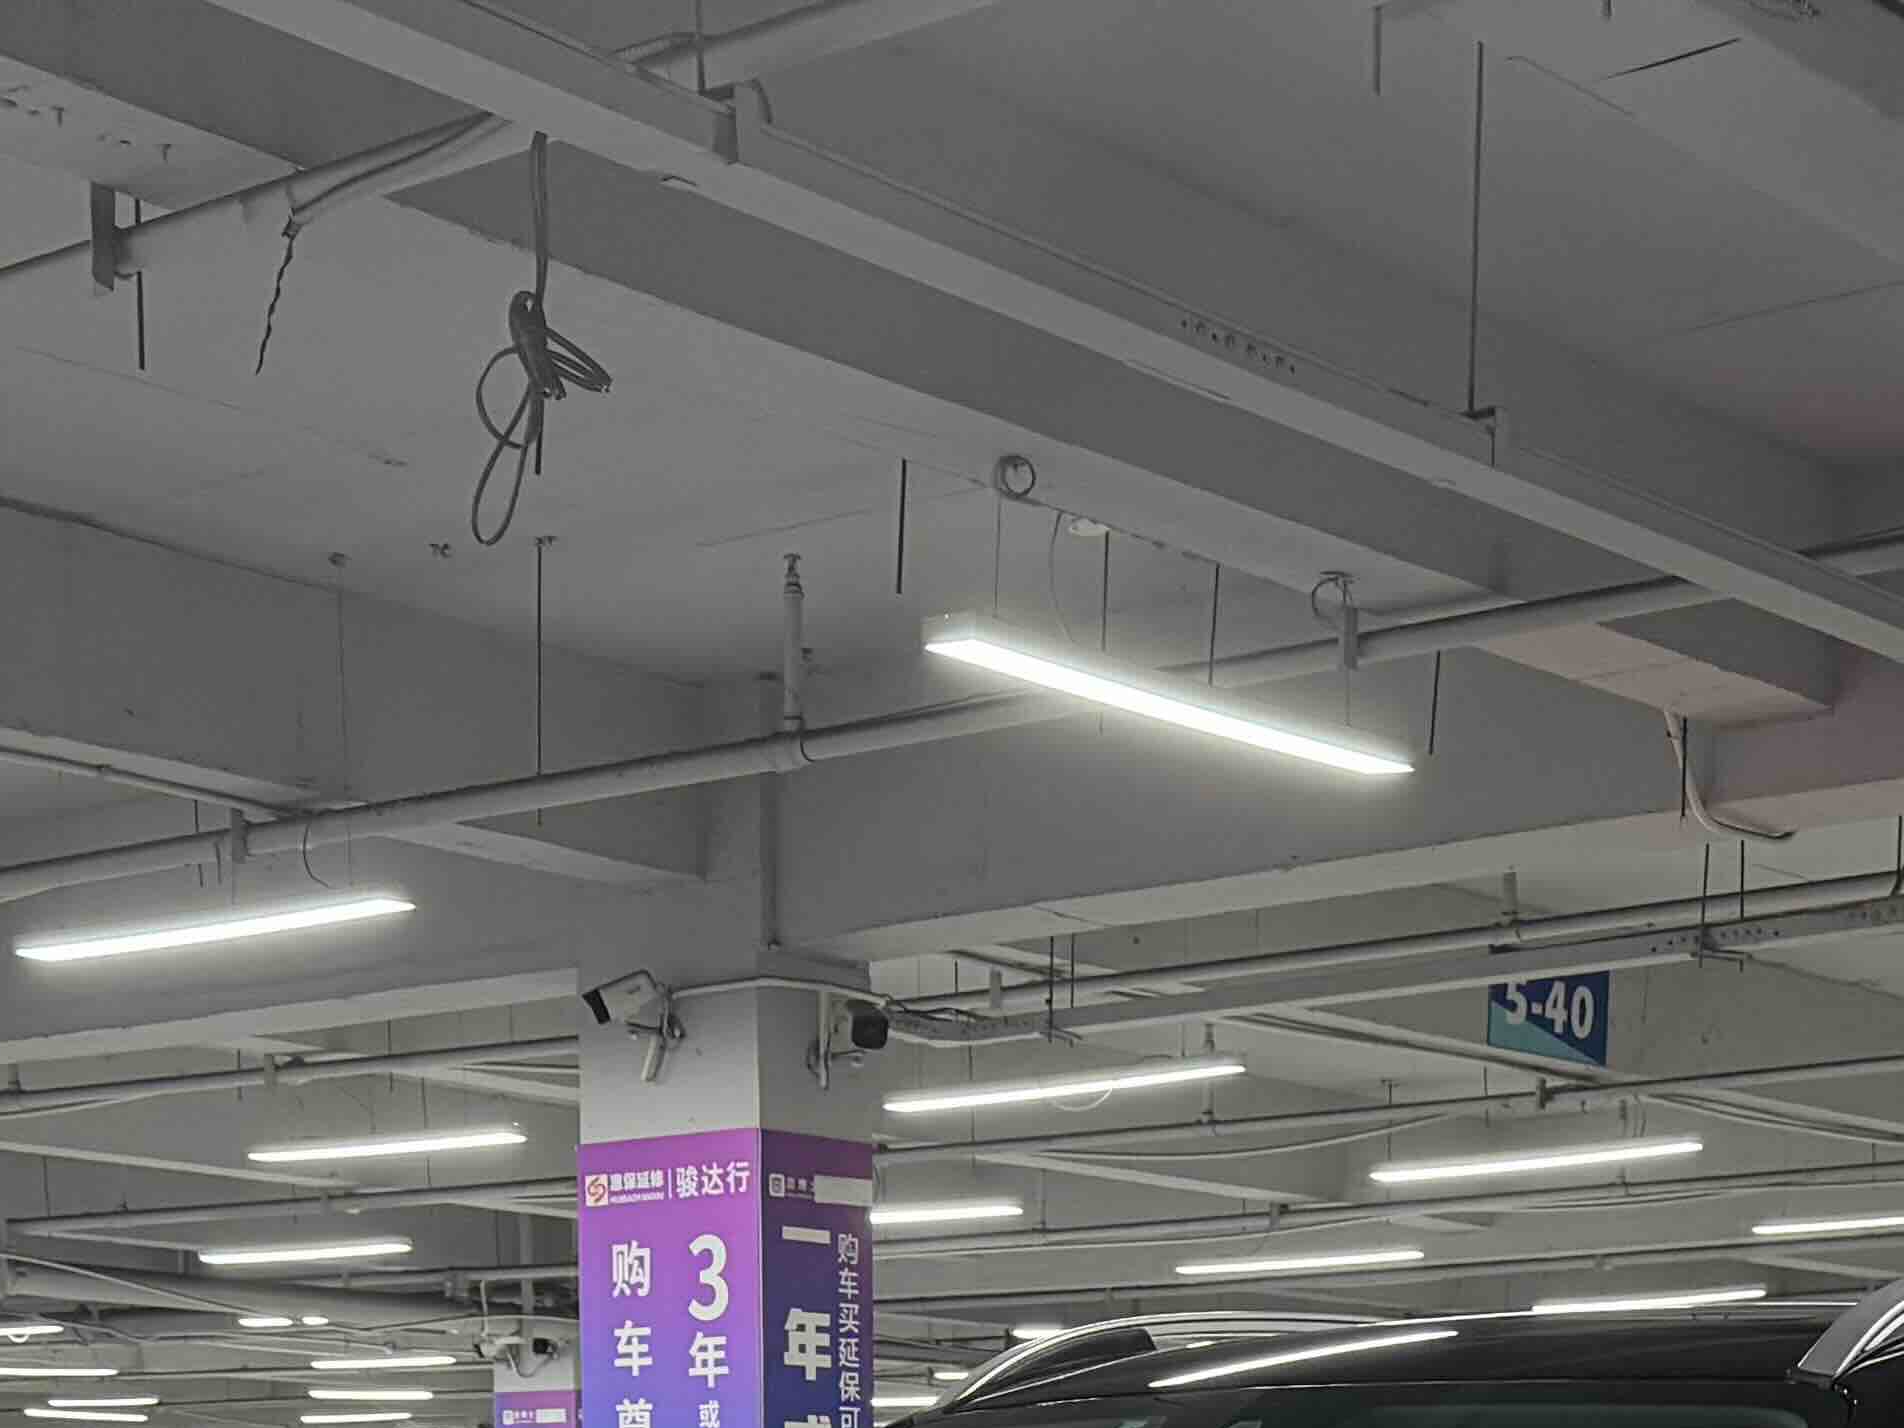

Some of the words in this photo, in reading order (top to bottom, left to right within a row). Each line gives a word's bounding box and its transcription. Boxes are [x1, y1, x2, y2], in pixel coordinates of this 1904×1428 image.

[1505, 977, 1595, 1040] 5-40
[676, 1162, 751, 1198] 骏达行
